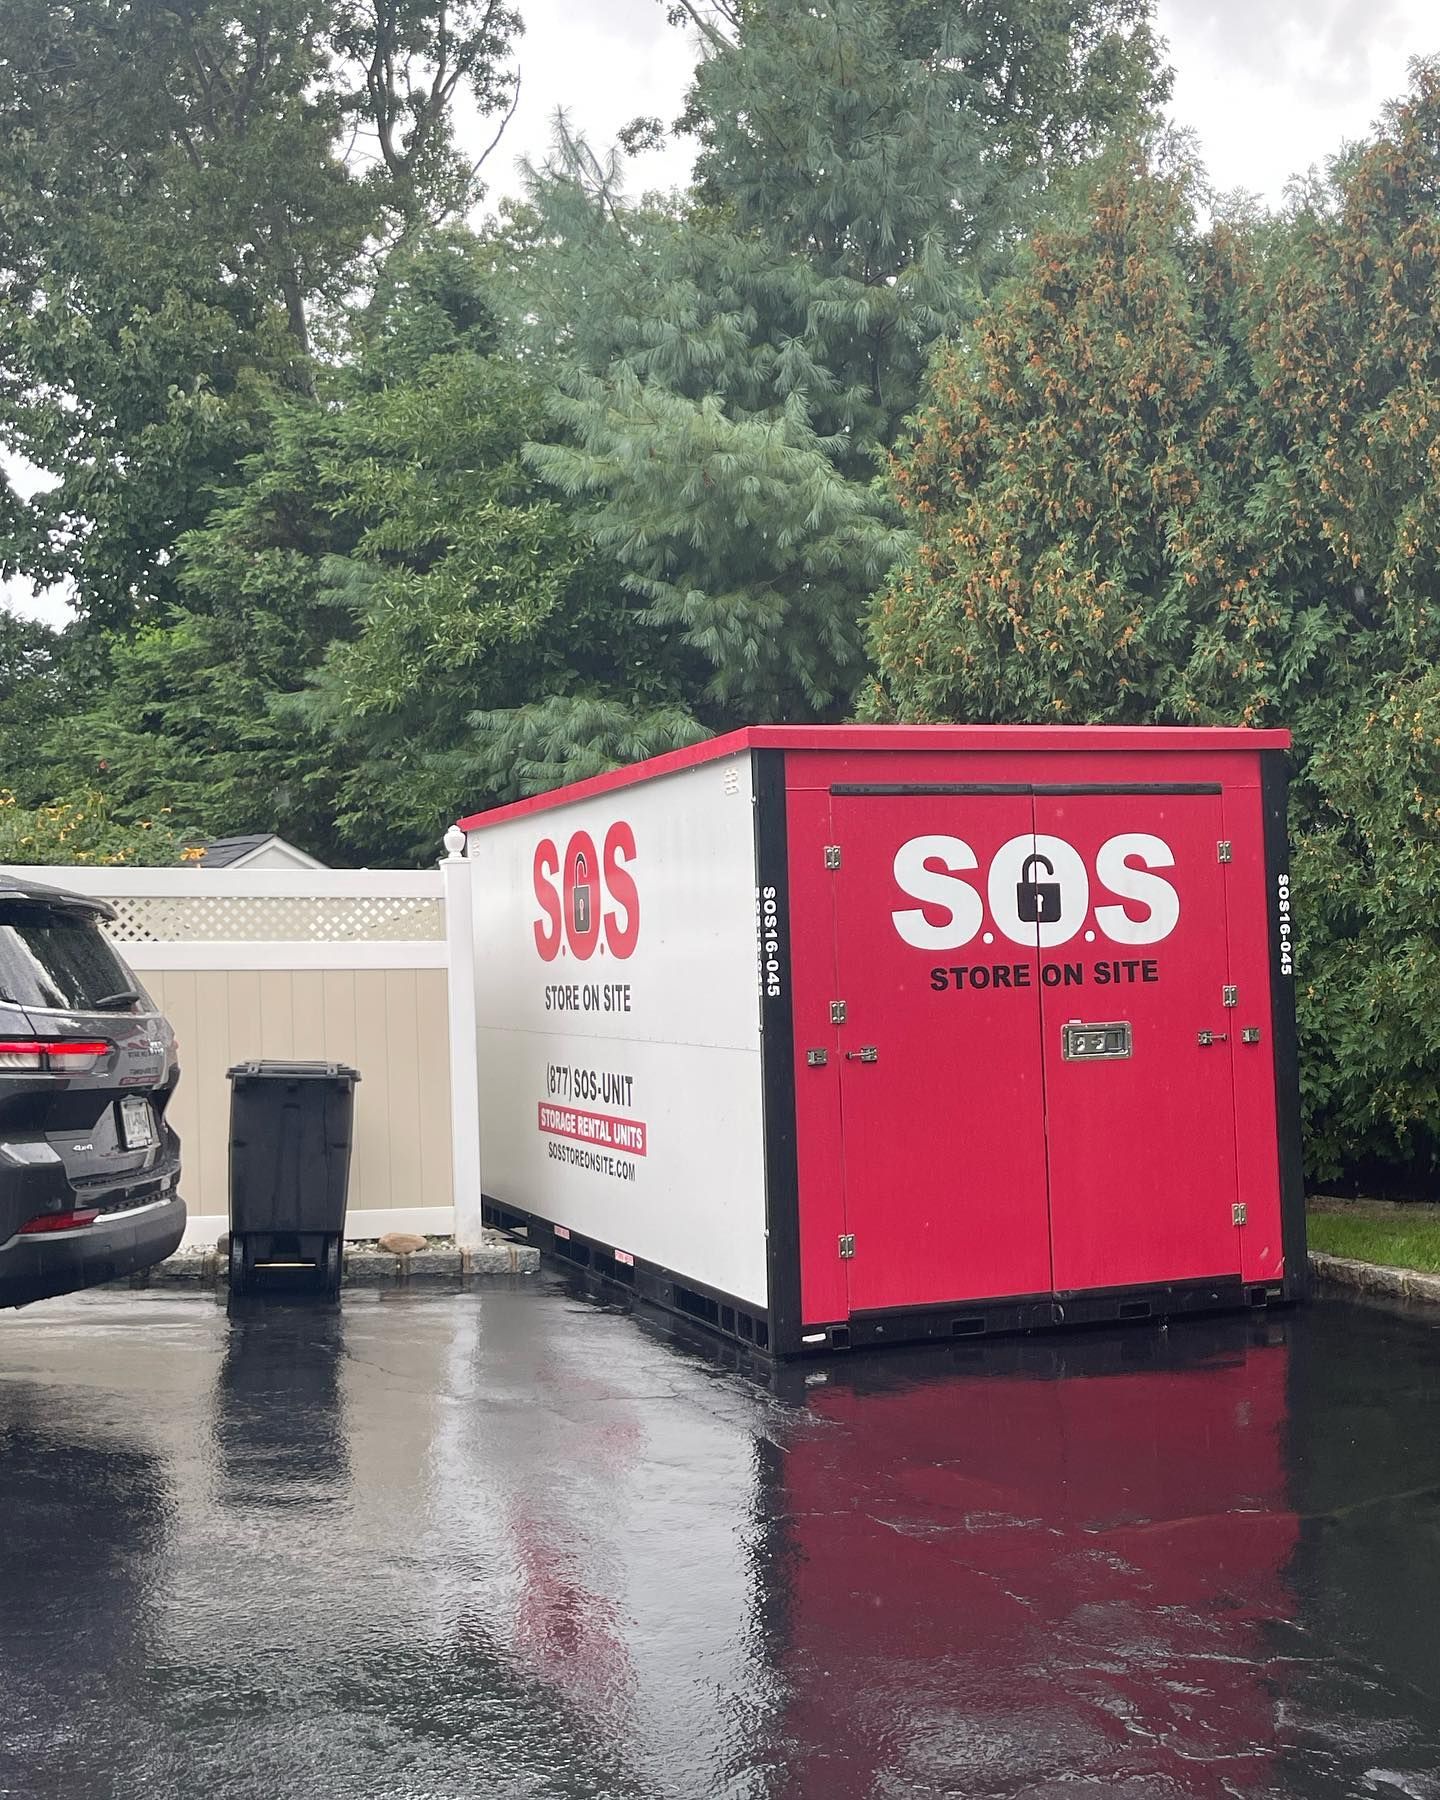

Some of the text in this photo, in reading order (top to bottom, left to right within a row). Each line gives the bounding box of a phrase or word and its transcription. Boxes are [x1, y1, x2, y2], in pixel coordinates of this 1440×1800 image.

[763, 886, 781, 997] SOS16-045
[1278, 873, 1292, 975] SOS16-045
[930, 959, 1159, 991] STORE ON SITE
[545, 984, 631, 1012] STORE ON SITE
[546, 1062, 633, 1107] (877) SOS-UNIT
[541, 1108, 643, 1149] STORAGE RENTAL UNITS
[548, 1141, 636, 1181] SOSSTOREONSITE.COM
